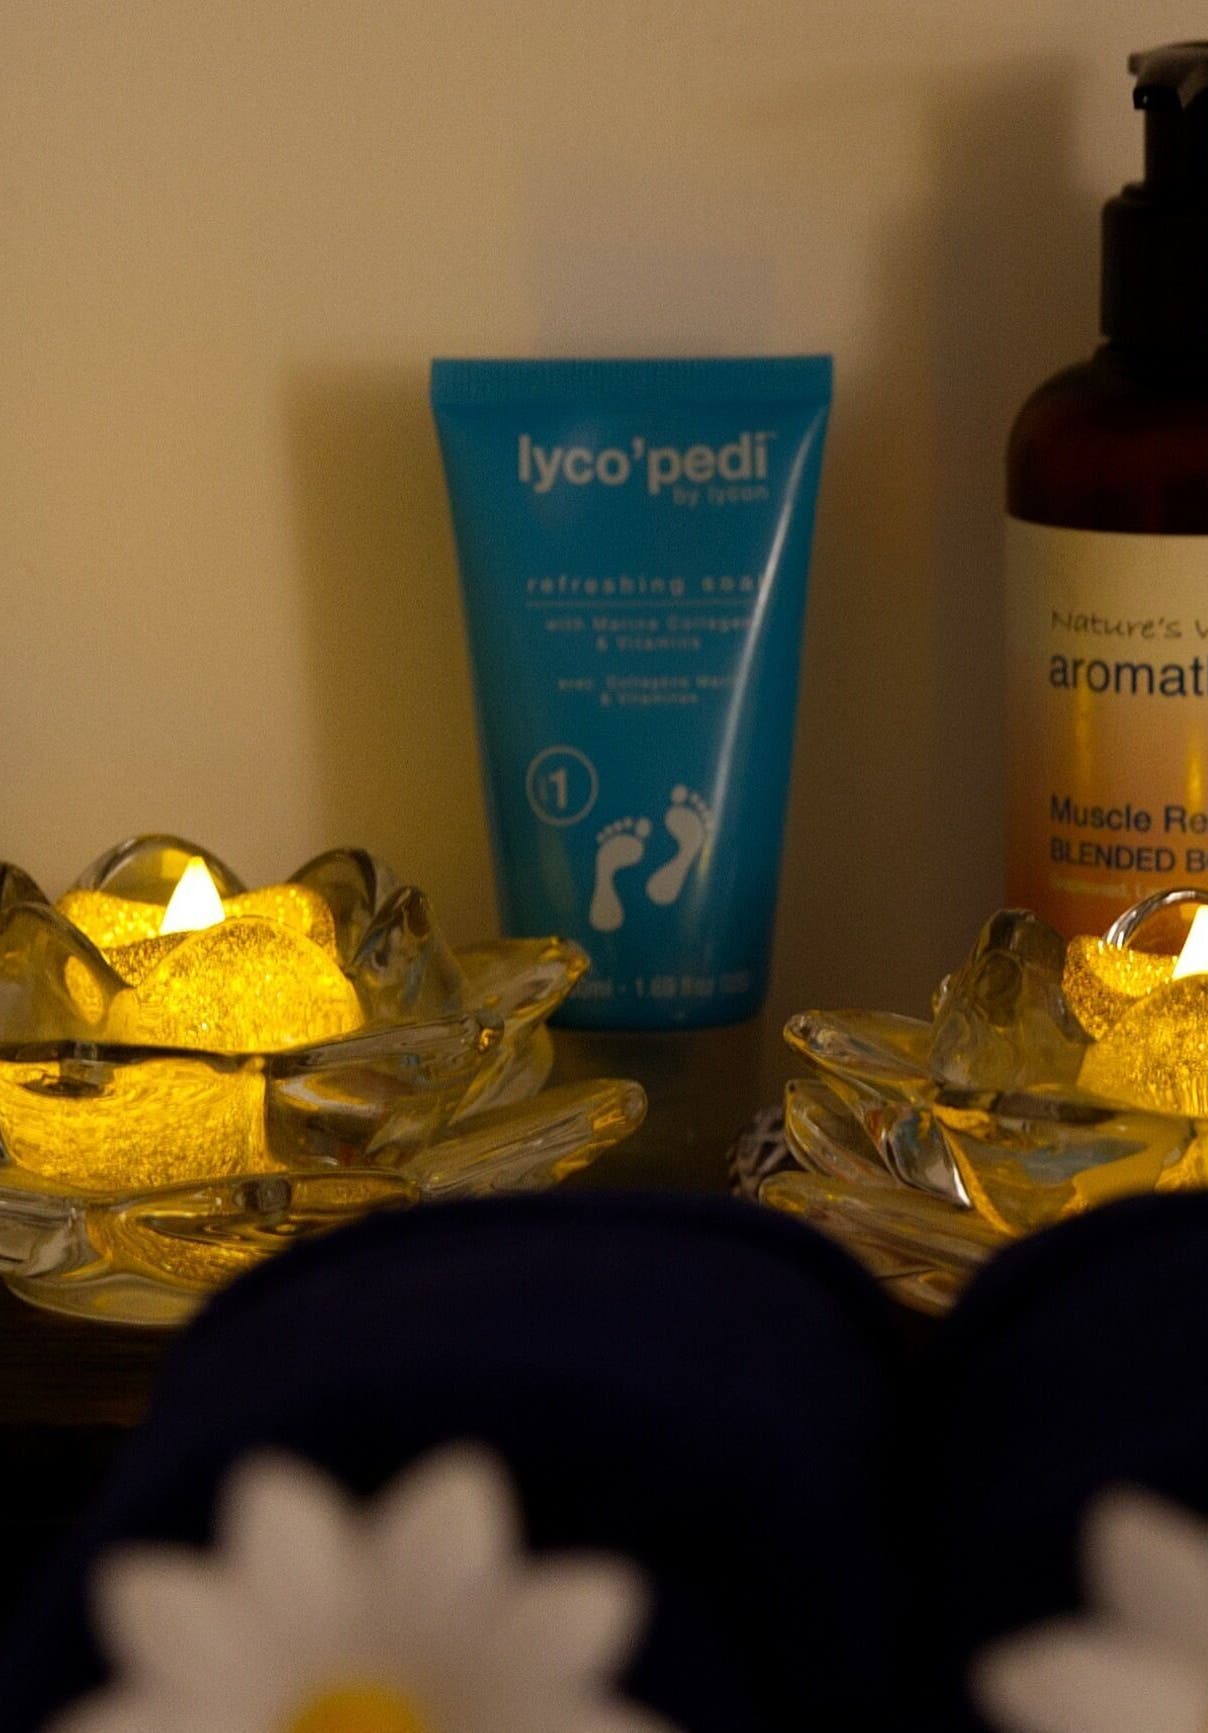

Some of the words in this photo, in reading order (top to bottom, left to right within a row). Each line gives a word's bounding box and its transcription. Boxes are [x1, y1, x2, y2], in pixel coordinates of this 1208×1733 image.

[527, 575, 686, 597] refreshing
[1051, 610, 1182, 640] Nature's
[549, 768, 568, 810] 1
[1051, 795, 1151, 833] Muscle
[1051, 837, 1176, 873] BLENDED
